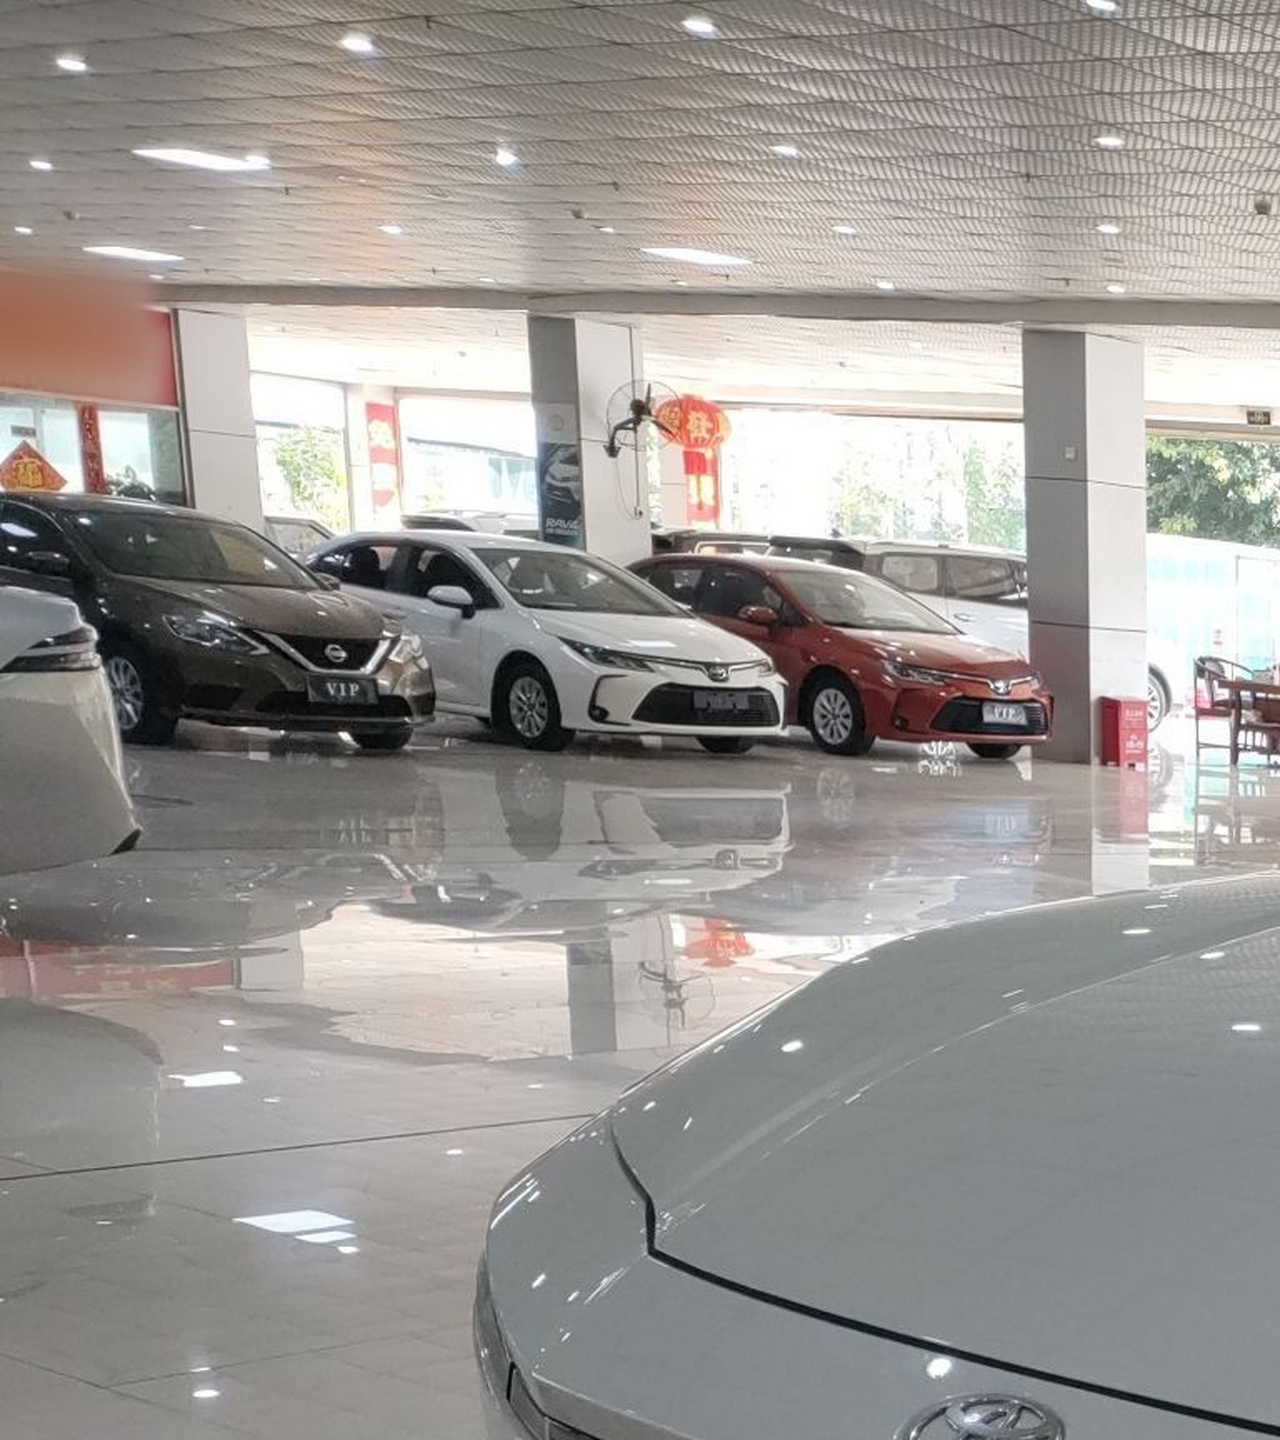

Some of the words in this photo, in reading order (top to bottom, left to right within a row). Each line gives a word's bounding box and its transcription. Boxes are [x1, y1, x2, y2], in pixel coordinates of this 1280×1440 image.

[546, 517, 578, 529] RAV4
[326, 682, 360, 696] VIP
[994, 706, 1015, 719] VIP
